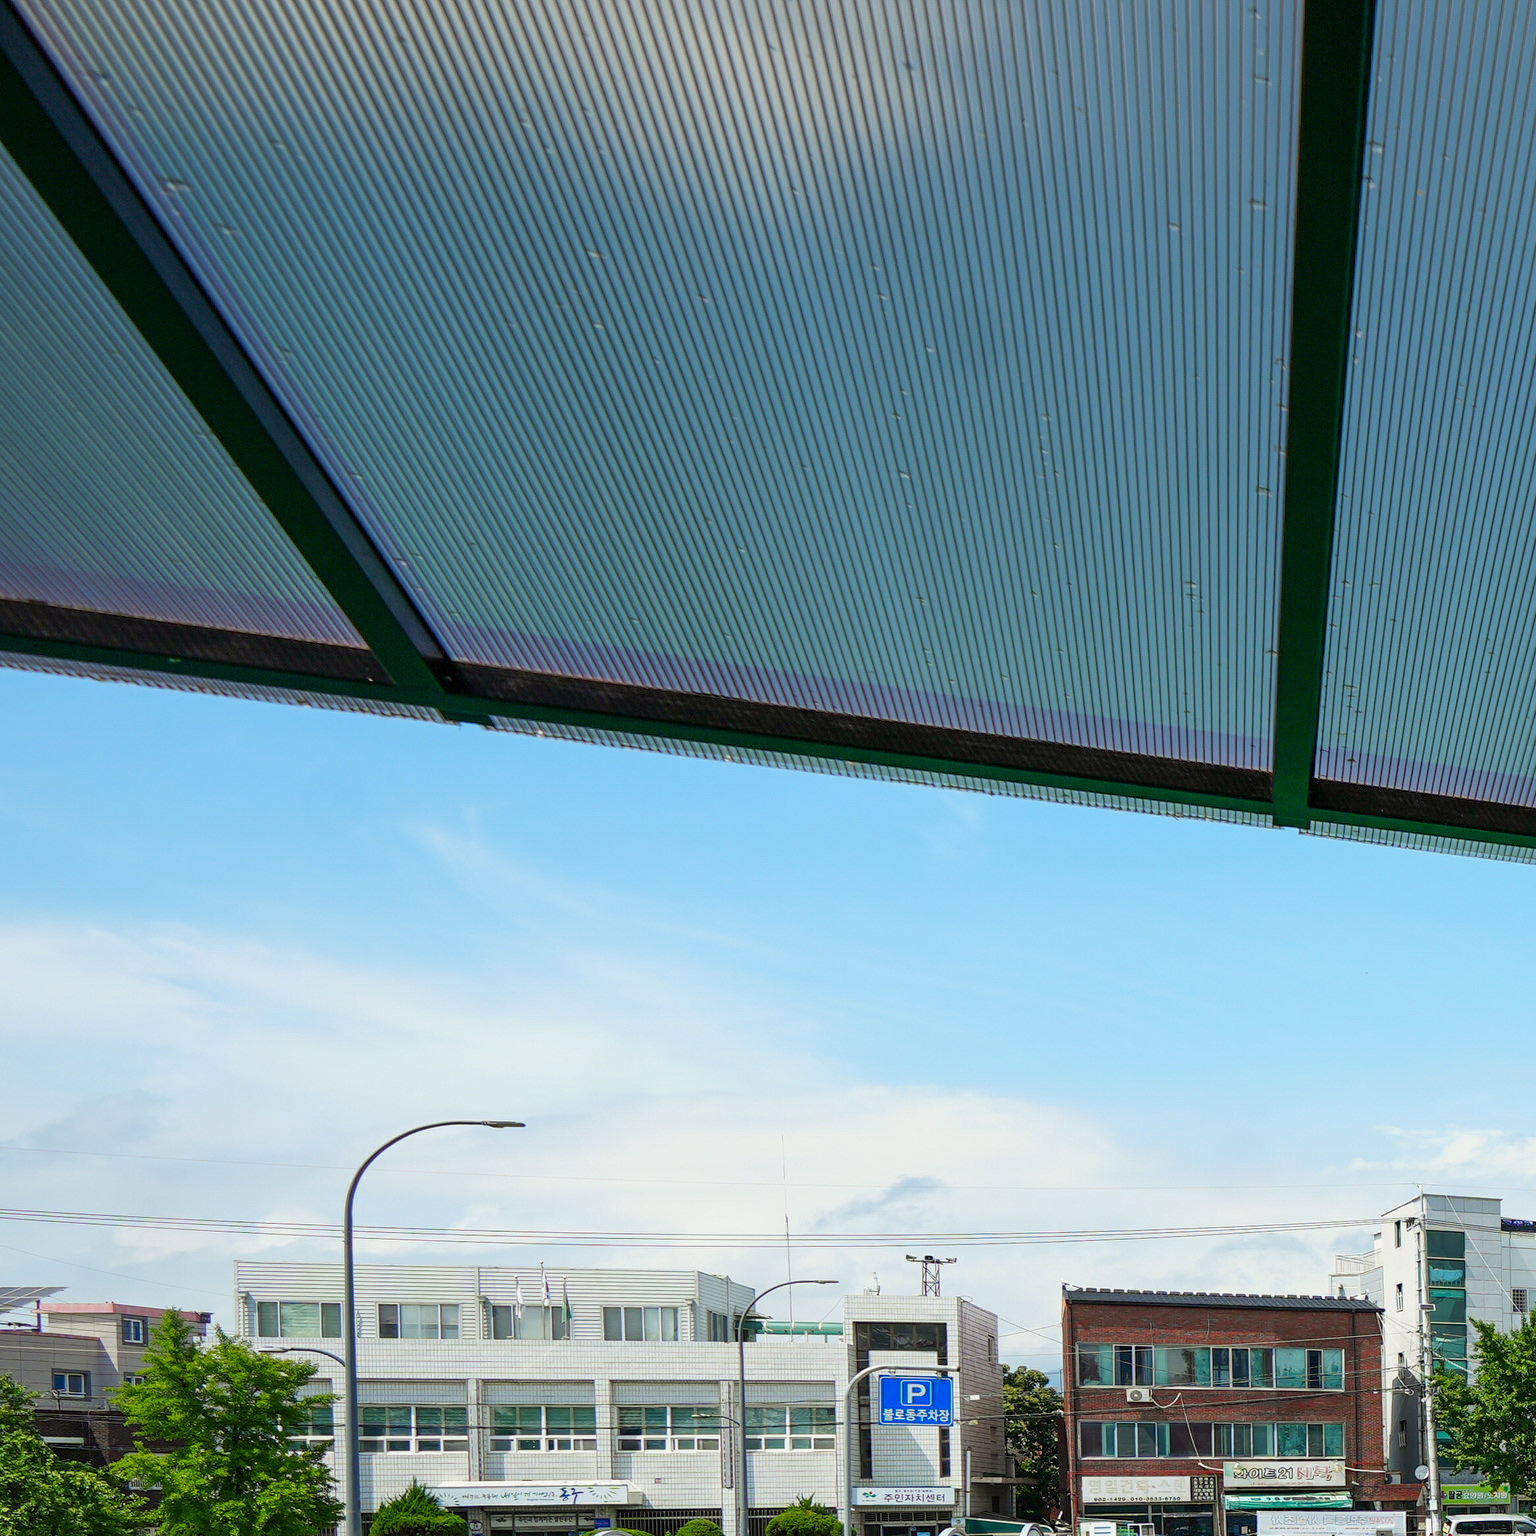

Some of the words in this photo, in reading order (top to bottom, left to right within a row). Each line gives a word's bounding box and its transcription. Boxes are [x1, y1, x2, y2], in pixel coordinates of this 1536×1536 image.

[907, 1383, 927, 1404] P
[883, 1408, 950, 1422] 불로동주차장
[559, 1487, 584, 1505] 동구
[884, 1493, 945, 1503] 주민자치센터
